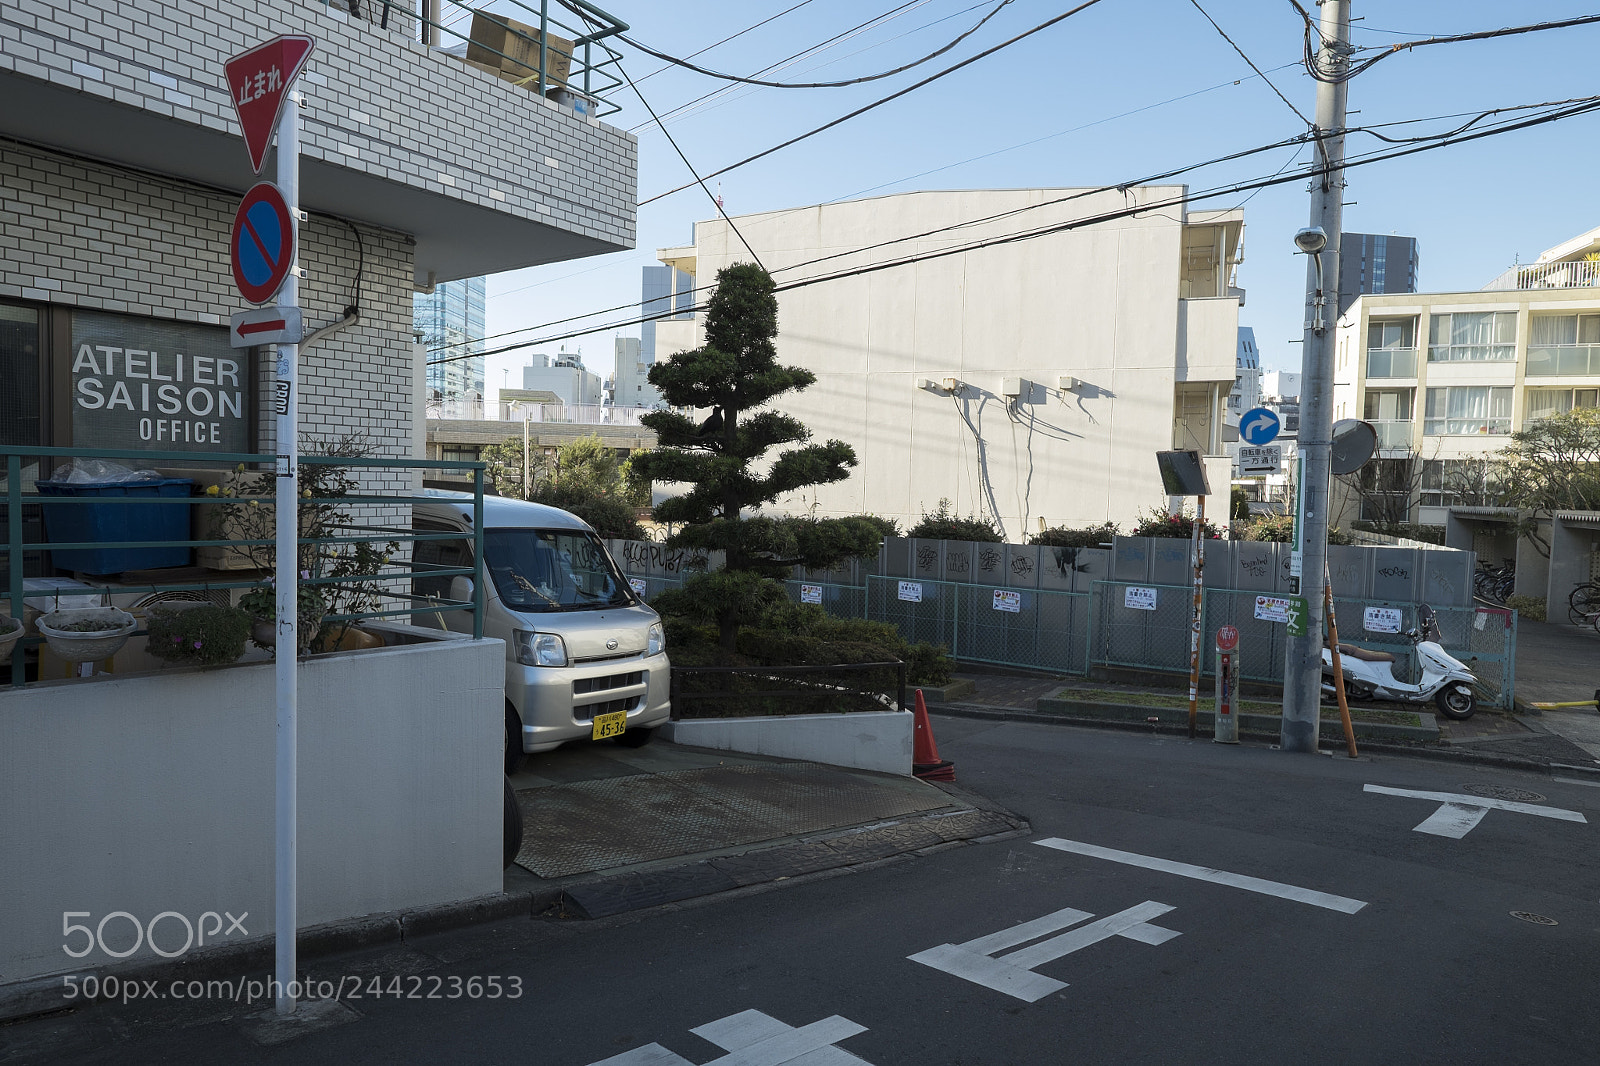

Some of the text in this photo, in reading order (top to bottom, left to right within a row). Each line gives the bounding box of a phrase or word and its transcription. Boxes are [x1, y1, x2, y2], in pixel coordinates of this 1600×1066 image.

[238, 64, 283, 106] 止まれ
[72, 344, 240, 387] ATELIER
[77, 377, 242, 419] SAISON
[139, 417, 221, 444] OFFICE
[1241, 456, 1278, 465] 一方通行
[600, 720, 625, 737] 45-36
